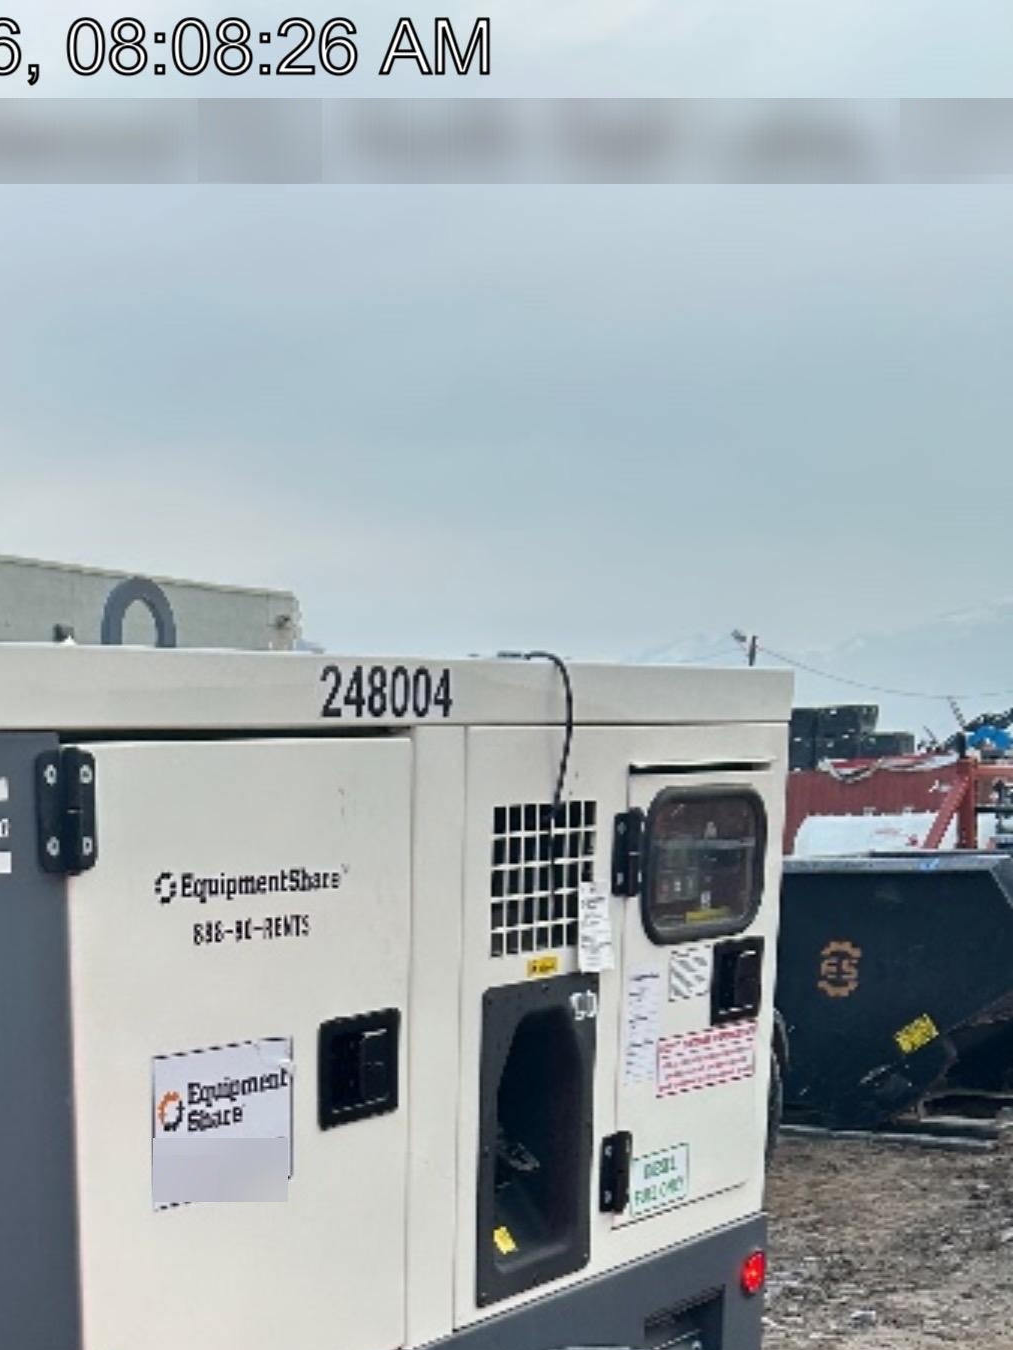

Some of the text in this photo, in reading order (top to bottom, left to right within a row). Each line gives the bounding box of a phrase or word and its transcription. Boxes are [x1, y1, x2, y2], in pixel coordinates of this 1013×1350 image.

[320, 665, 453, 718] 248004
[181, 866, 341, 904] EquipmentShare
[187, 1067, 289, 1107] Equipment
